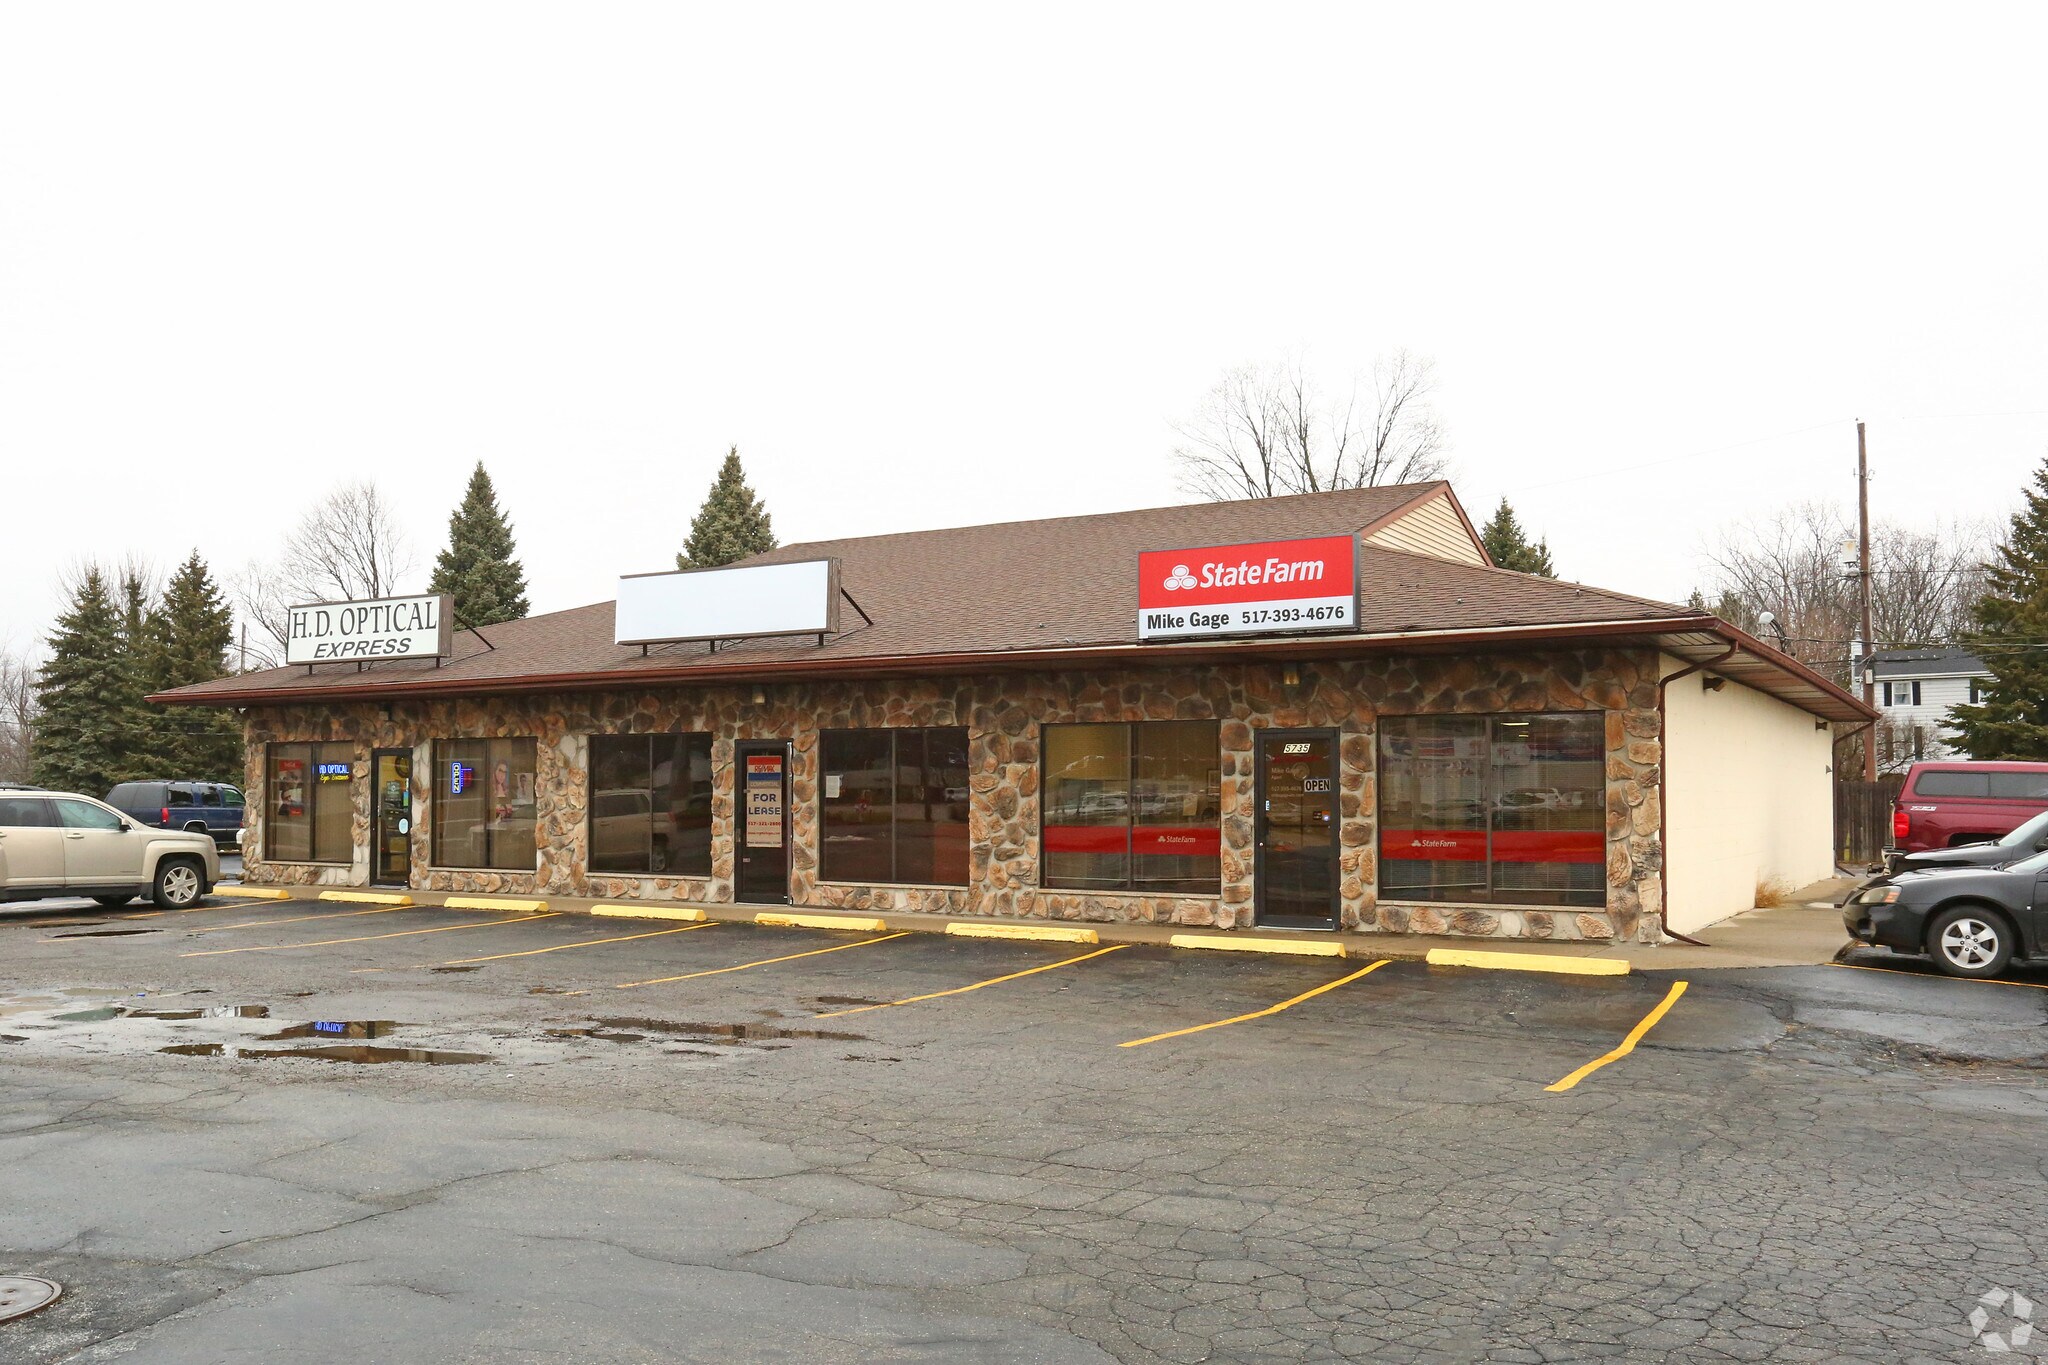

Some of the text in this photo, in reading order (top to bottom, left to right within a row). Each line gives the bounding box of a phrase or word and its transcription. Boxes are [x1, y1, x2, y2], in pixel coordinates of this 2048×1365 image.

[291, 601, 437, 639] H.D. OPTICAL
[1147, 605, 1345, 630] Mike Gage 517-393-4676
[313, 637, 412, 659] EXPRESS
[1285, 744, 1309, 752] 5735
[319, 764, 350, 773] HD OPTICAL
[1305, 780, 1330, 791] OPEN
[753, 793, 777, 802] FOR
[749, 807, 781, 815] LEASE
